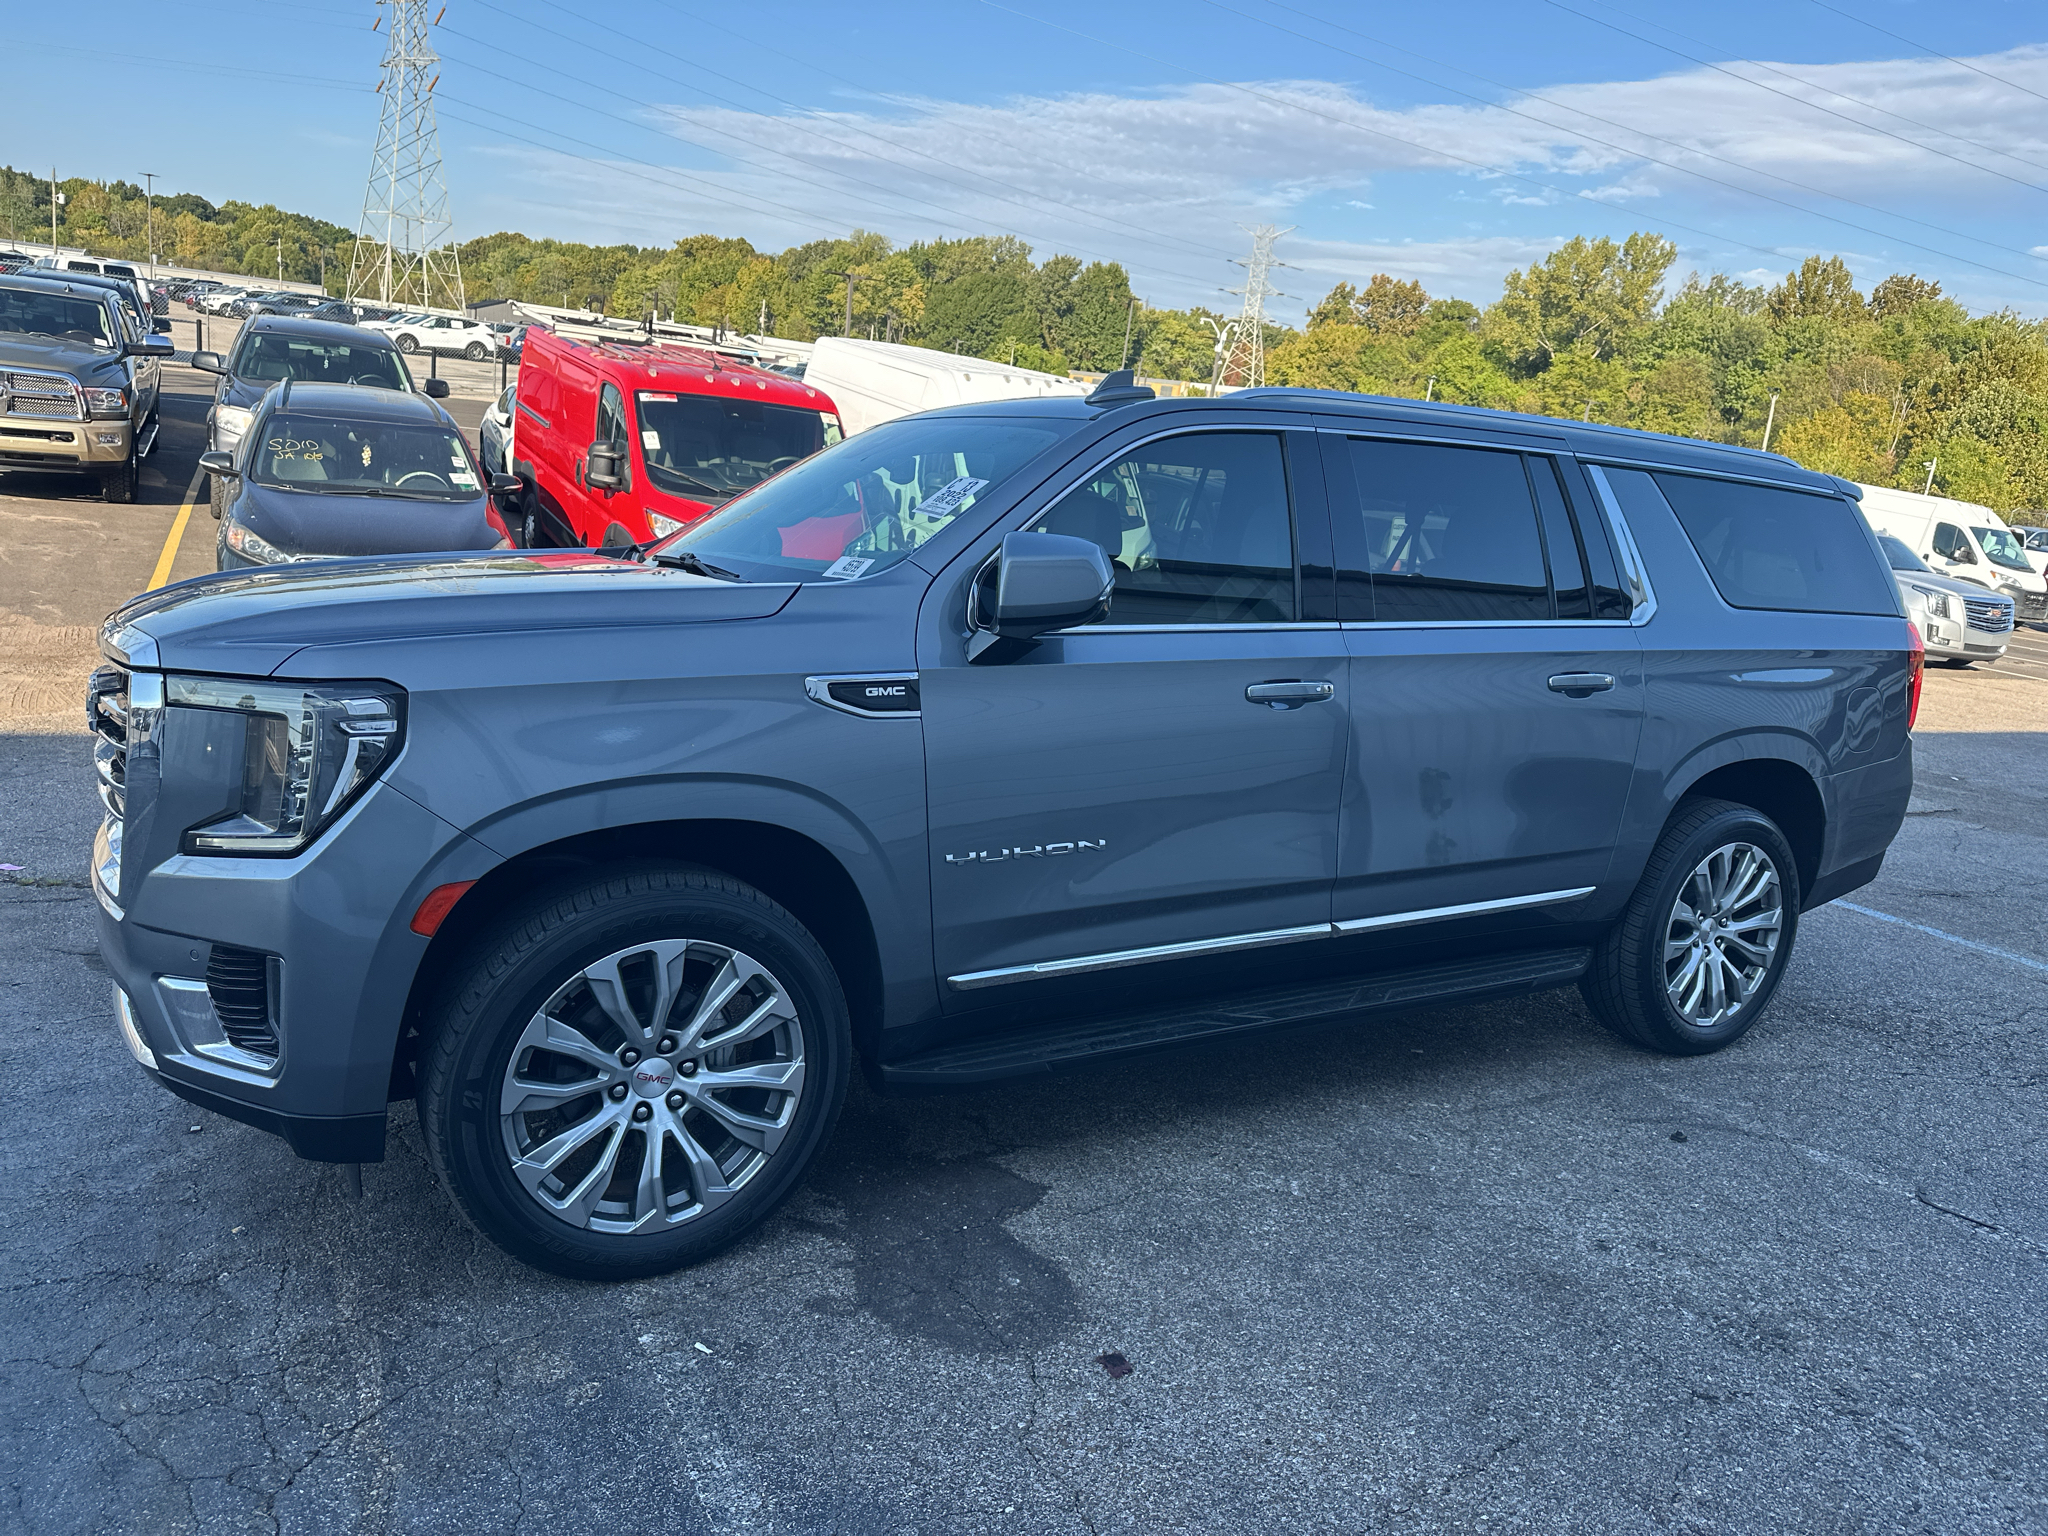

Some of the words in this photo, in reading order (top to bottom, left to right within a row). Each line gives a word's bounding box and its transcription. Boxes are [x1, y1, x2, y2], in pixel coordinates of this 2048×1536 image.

[941, 489, 967, 500] 2022
[865, 686, 906, 697] GMC
[945, 839, 1106, 866] YUKON
[636, 1072, 671, 1085] GMC
[528, 1205, 754, 1266] BRIDGESTONE
